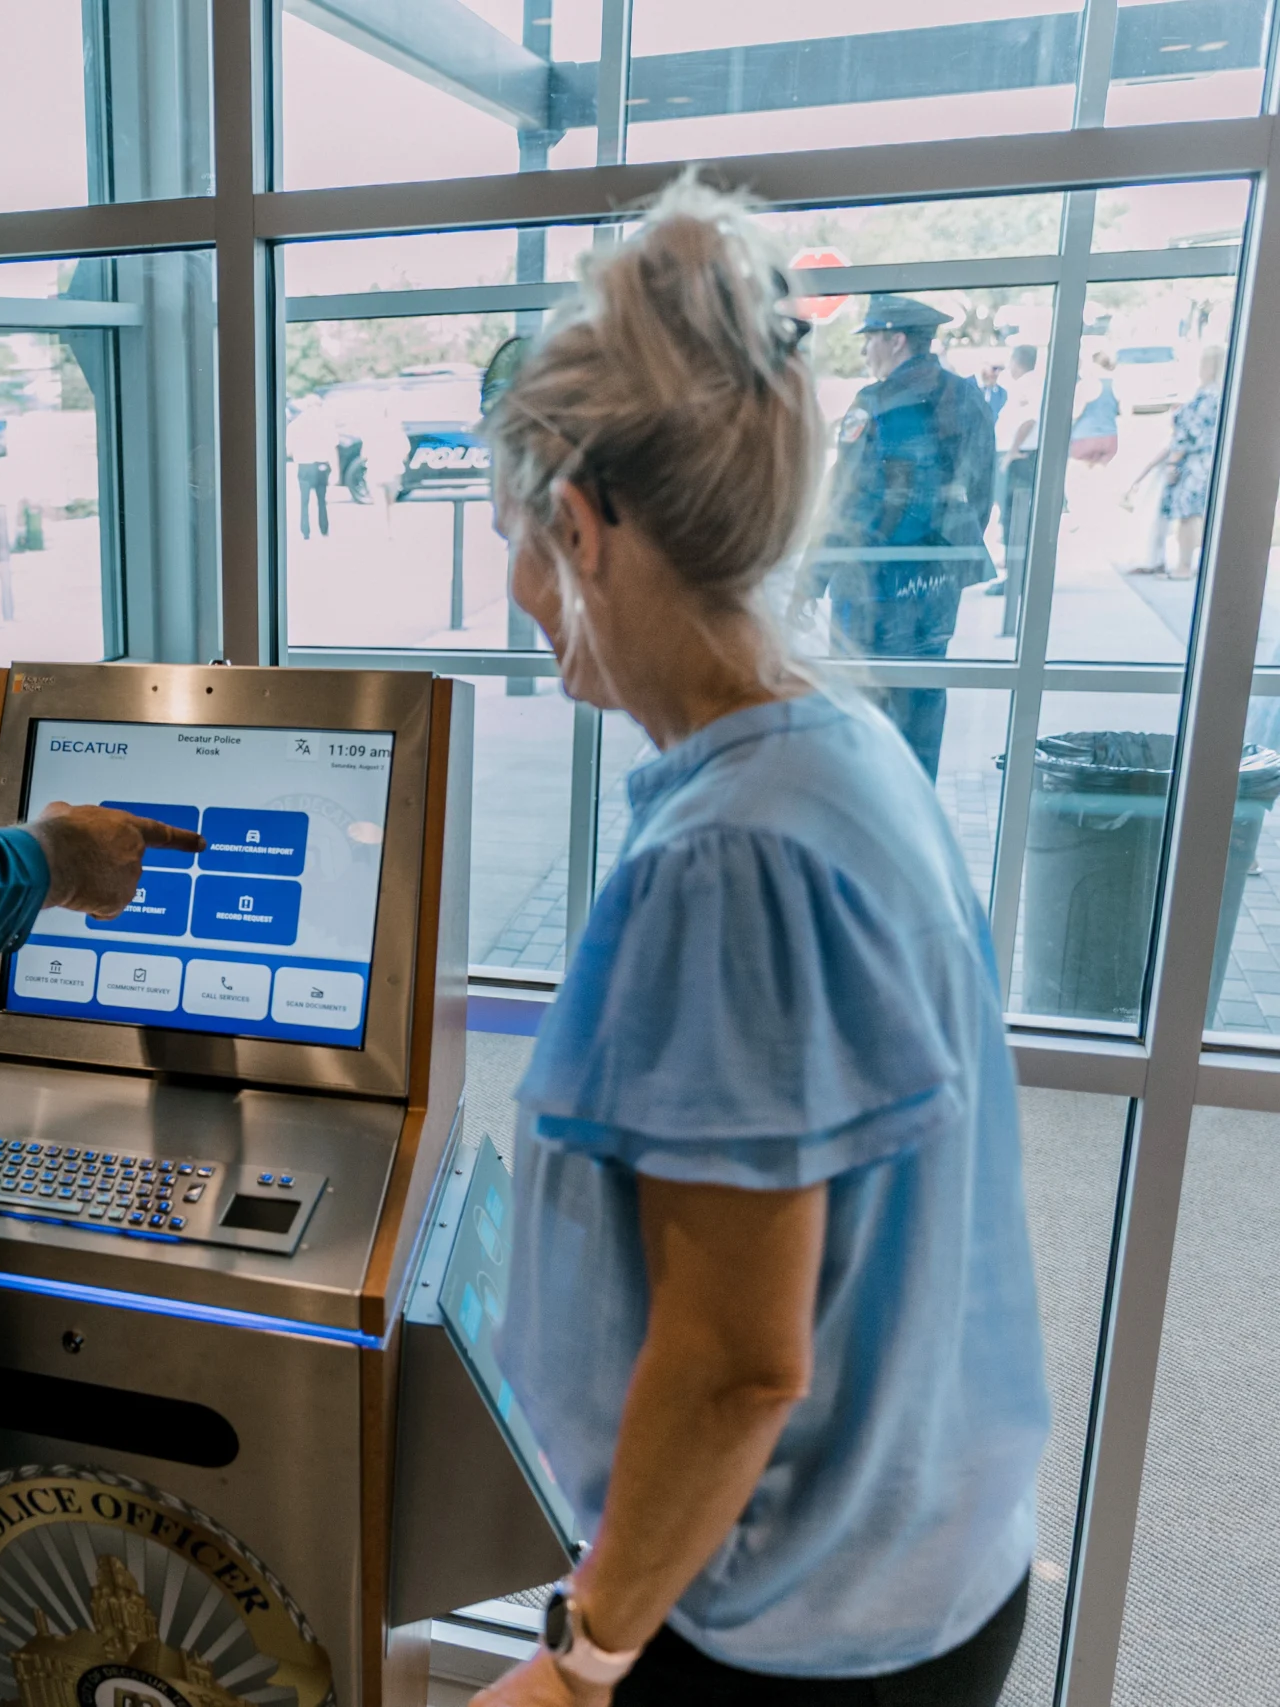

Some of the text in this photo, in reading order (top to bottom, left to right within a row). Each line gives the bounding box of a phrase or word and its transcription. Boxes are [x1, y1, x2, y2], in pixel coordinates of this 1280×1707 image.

[409, 446, 491, 469] POLIC
[178, 734, 241, 745] Decatur Police
[50, 740, 128, 755] DECATUR
[195, 747, 220, 756] Kiosk
[329, 744, 390, 758] 11:09 am
[210, 843, 294, 856] ACCIDENT/CRASH REPORT
[142, 906, 167, 915] PERMIT
[216, 912, 273, 923] RECORD REQUEST
[25, 975, 49, 983] COURTS
[60, 978, 84, 987] TICKETS
[107, 983, 170, 995] COMMUNITY SURVEY
[201, 992, 250, 1003] CALL SERVICES
[286, 1000, 346, 1012] SCAN DOCUMENTS
[91, 1492, 271, 1616] OFFICER
